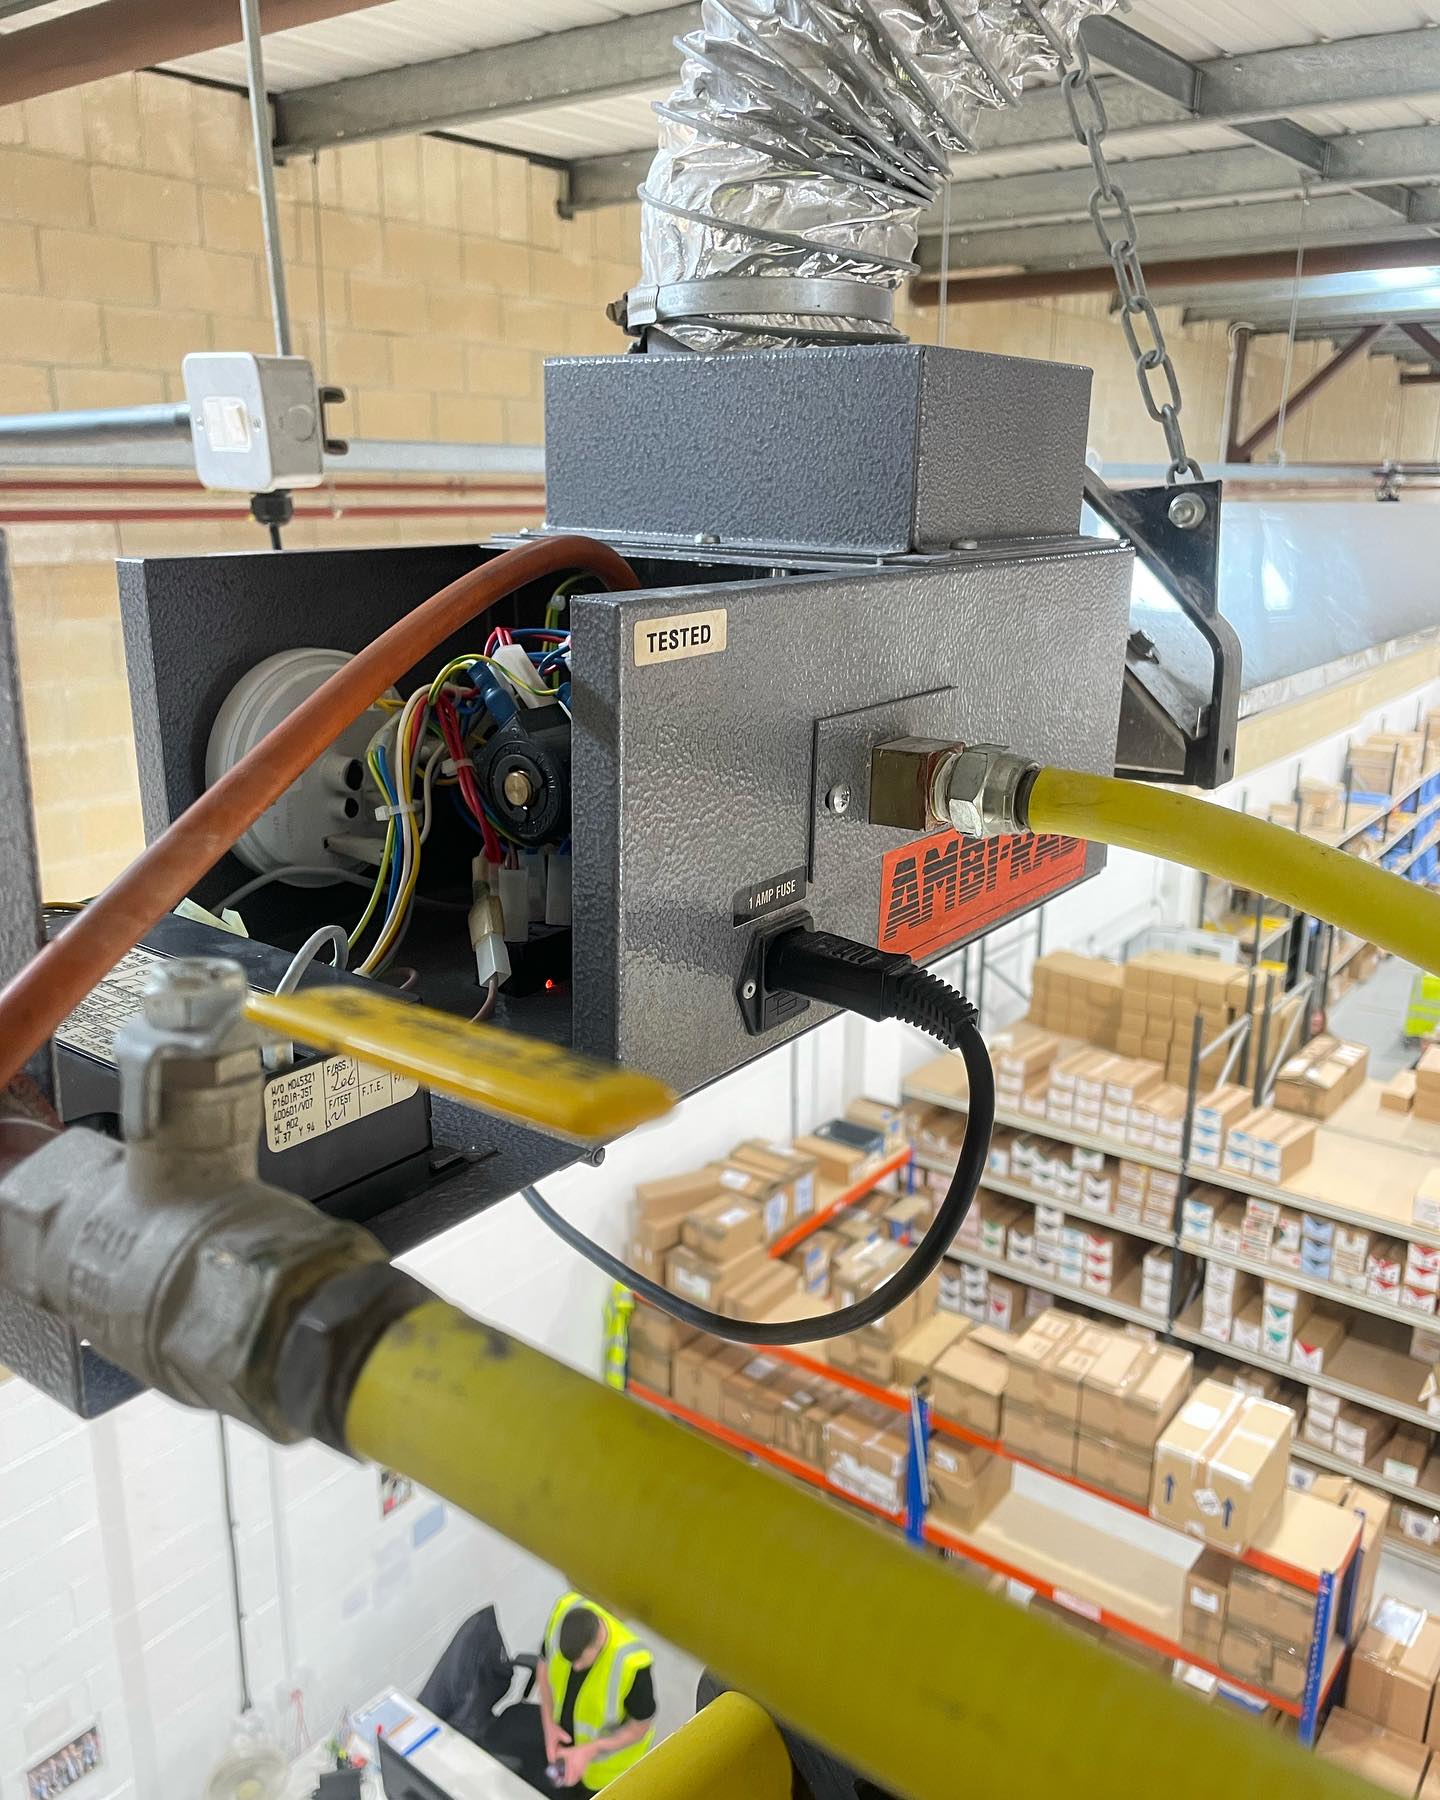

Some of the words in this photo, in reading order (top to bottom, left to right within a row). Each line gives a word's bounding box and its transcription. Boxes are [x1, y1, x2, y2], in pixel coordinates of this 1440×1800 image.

[646, 624, 711, 653] TESTED
[749, 897, 753, 910] 1
[755, 888, 774, 908] AMP
[776, 879, 796, 899] FUSE
[362, 1080, 384, 1097] F.T.E.
[328, 1092, 352, 1110] F/TEST
[283, 1131, 292, 1144] 37
